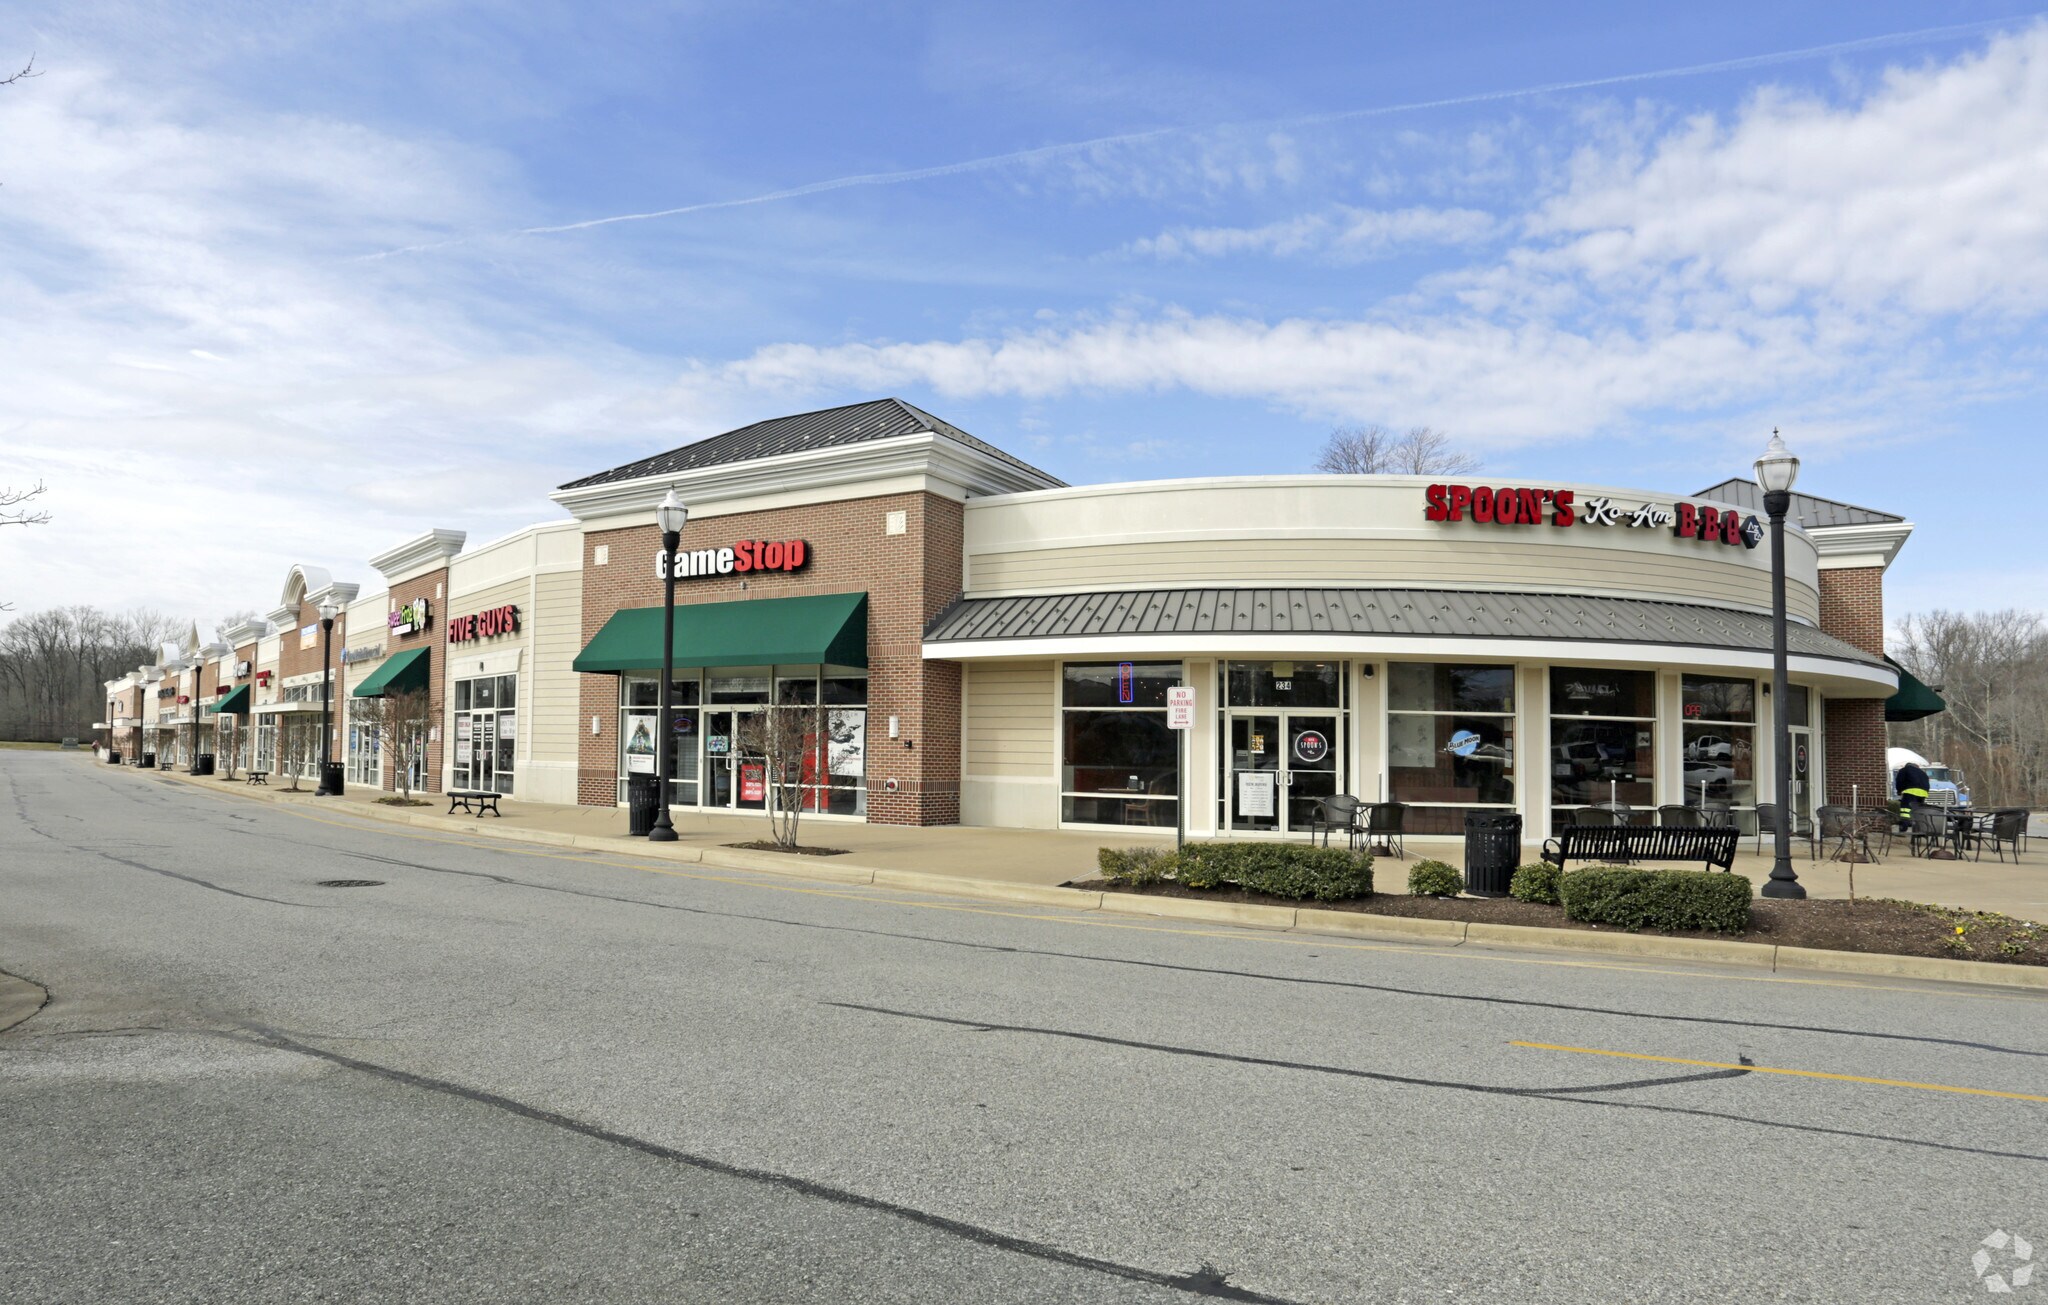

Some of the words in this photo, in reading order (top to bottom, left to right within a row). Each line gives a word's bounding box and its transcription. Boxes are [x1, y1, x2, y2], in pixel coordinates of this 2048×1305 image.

[1426, 484, 1574, 526] SPOON'S
[1585, 497, 1672, 528] Ko-Am
[656, 539, 805, 579] GameStop
[449, 614, 474, 643] FIVE
[477, 605, 514, 637] GUYS
[1121, 664, 1131, 701] OPEN
[1276, 681, 1291, 690] 234
[1449, 740, 1464, 749] BLUE
[1464, 736, 1480, 745] MOON
